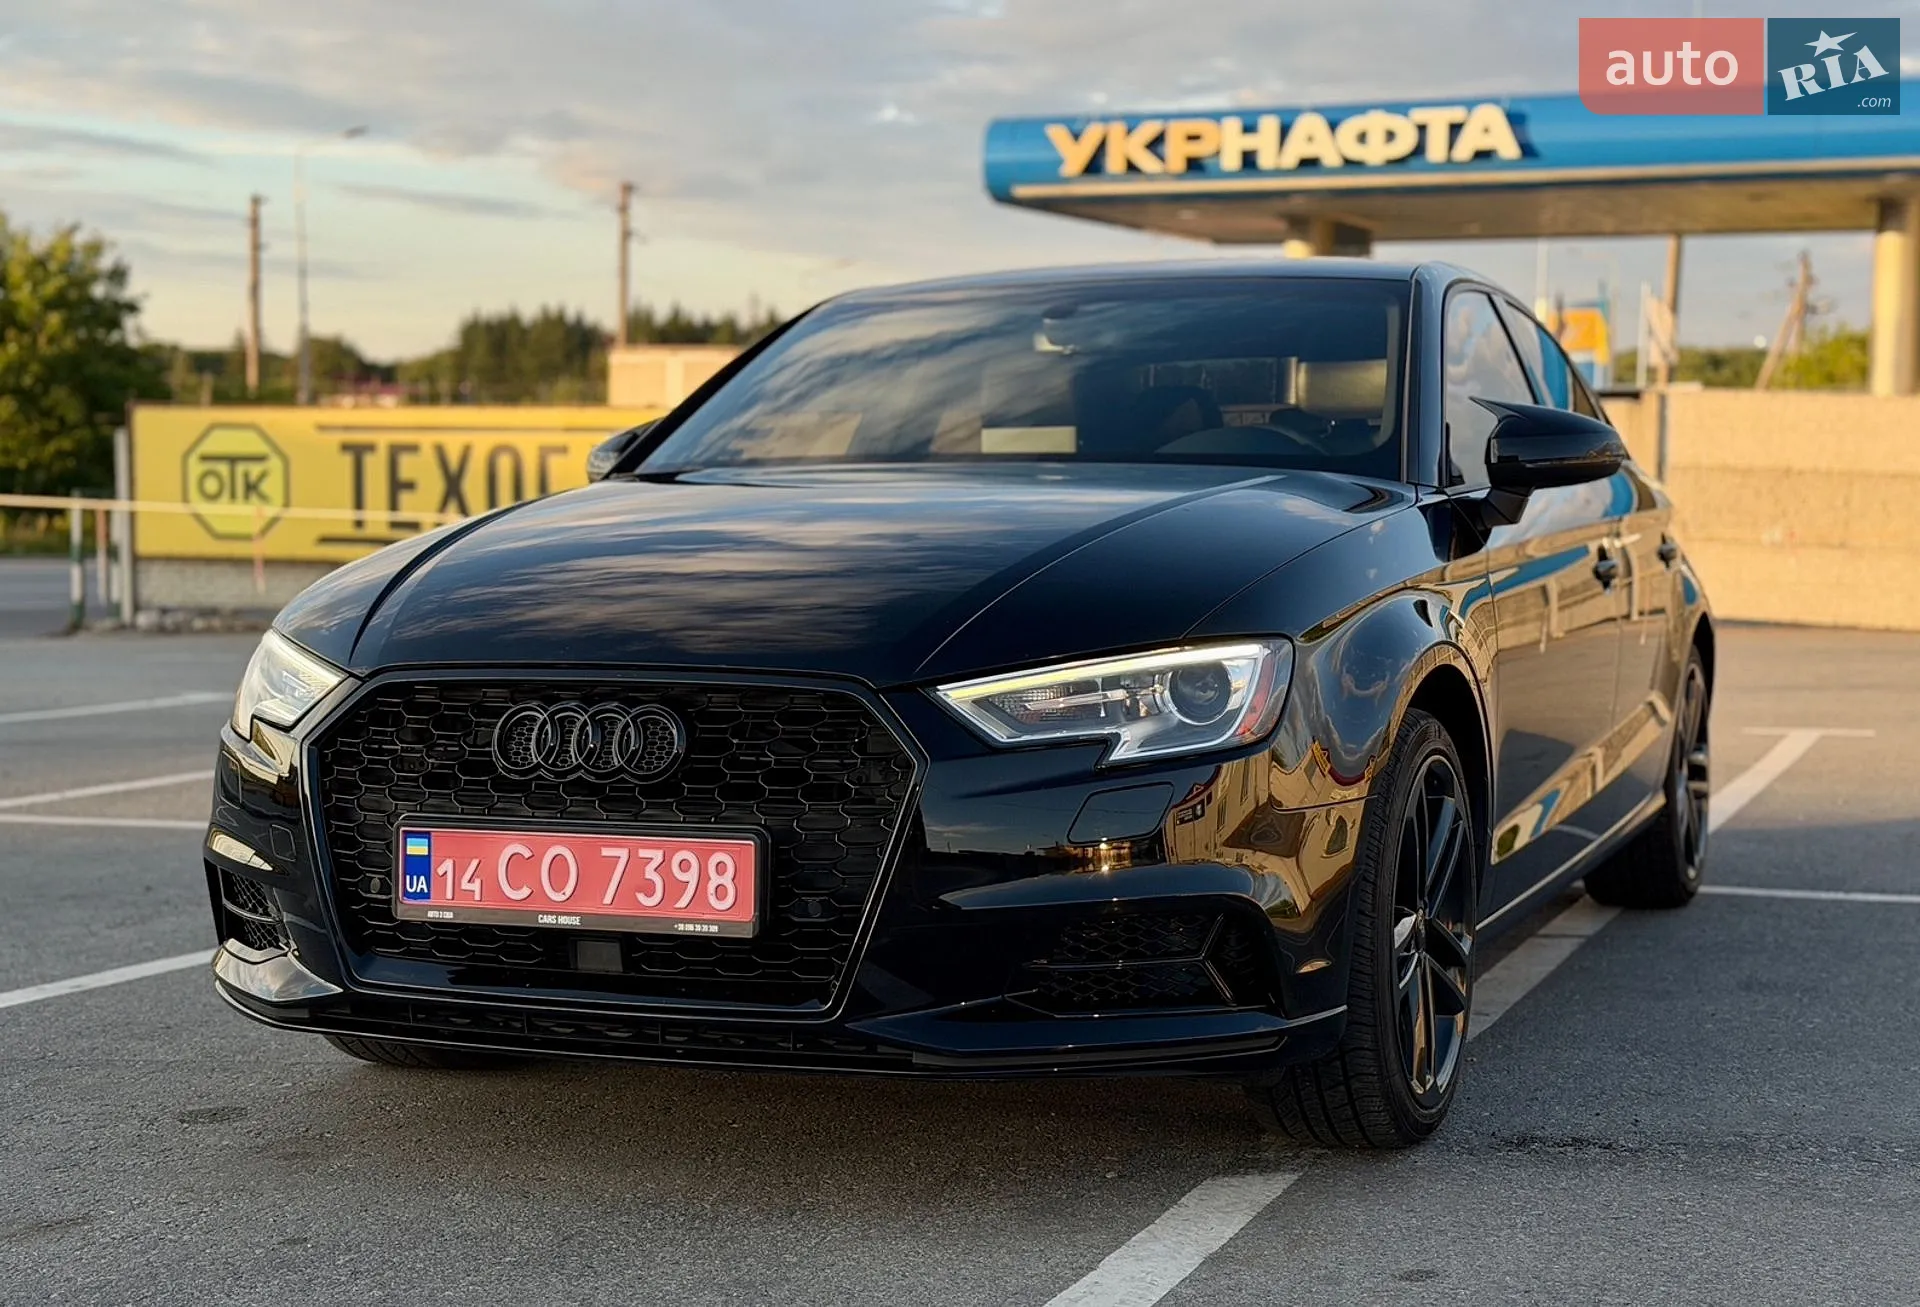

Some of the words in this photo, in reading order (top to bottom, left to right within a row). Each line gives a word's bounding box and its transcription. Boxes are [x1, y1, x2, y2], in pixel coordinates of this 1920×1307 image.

[1044, 102, 1522, 177] УКРНАФТА
[196, 454, 270, 503] ОТК
[405, 875, 428, 893] UA
[436, 858, 483, 901] 14
[497, 843, 580, 902] CO
[600, 847, 737, 912] 7398
[538, 914, 557, 924] CARS
[558, 915, 582, 926] HOUSE
